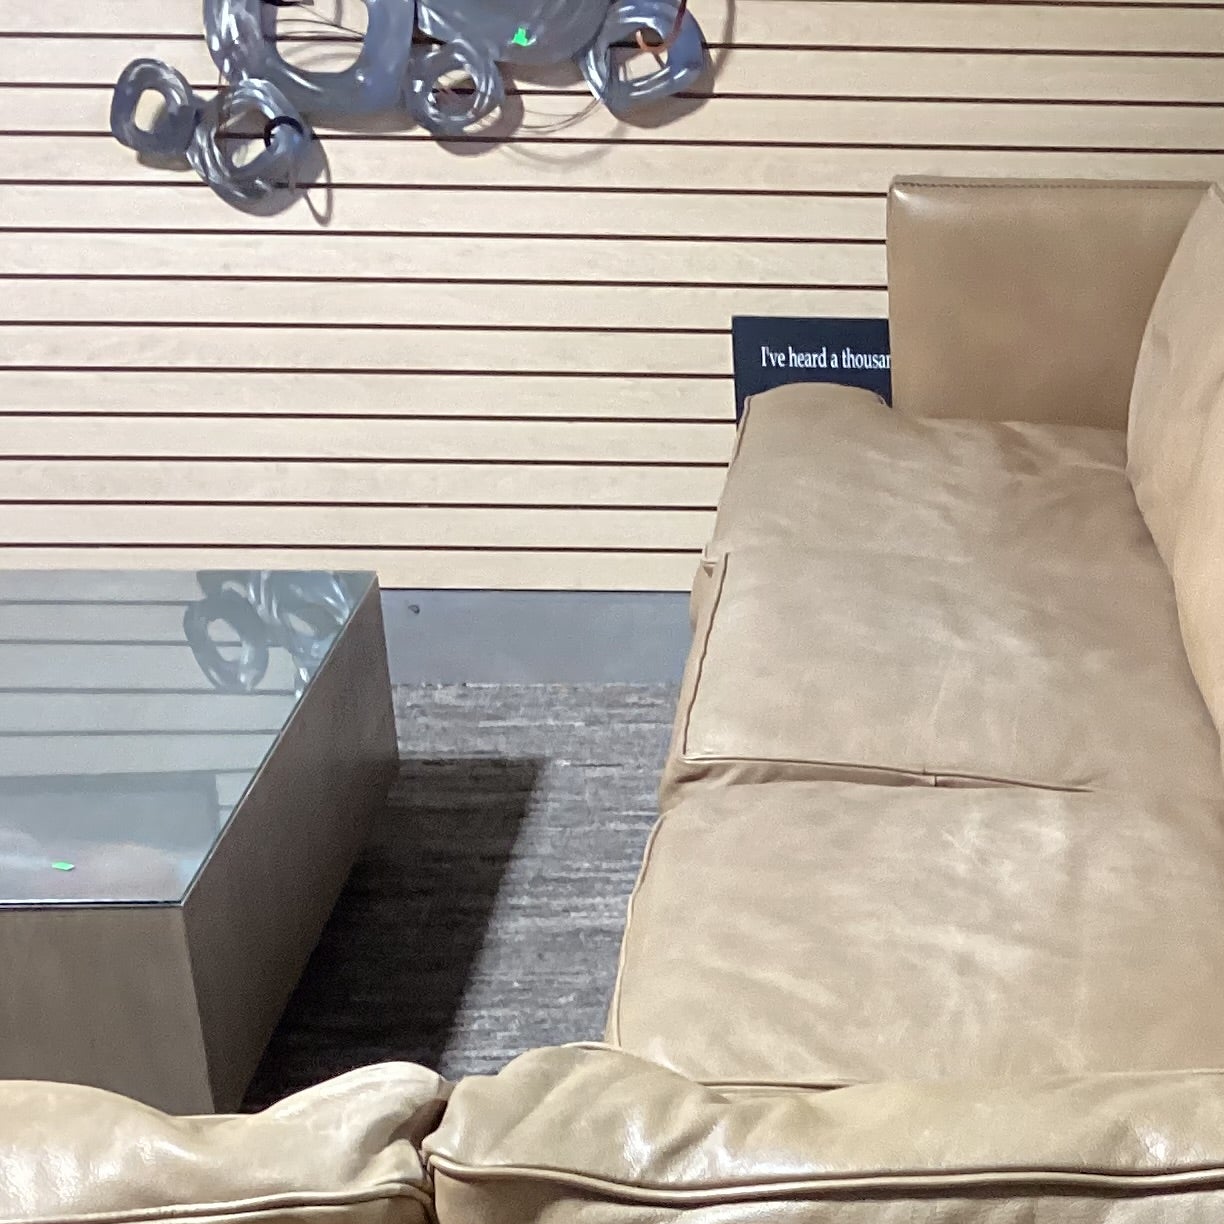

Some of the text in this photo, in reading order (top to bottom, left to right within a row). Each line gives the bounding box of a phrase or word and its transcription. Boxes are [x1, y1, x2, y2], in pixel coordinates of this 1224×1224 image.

[761, 346, 785, 367] I've
[788, 345, 827, 368] heard
[830, 352, 839, 368] a
